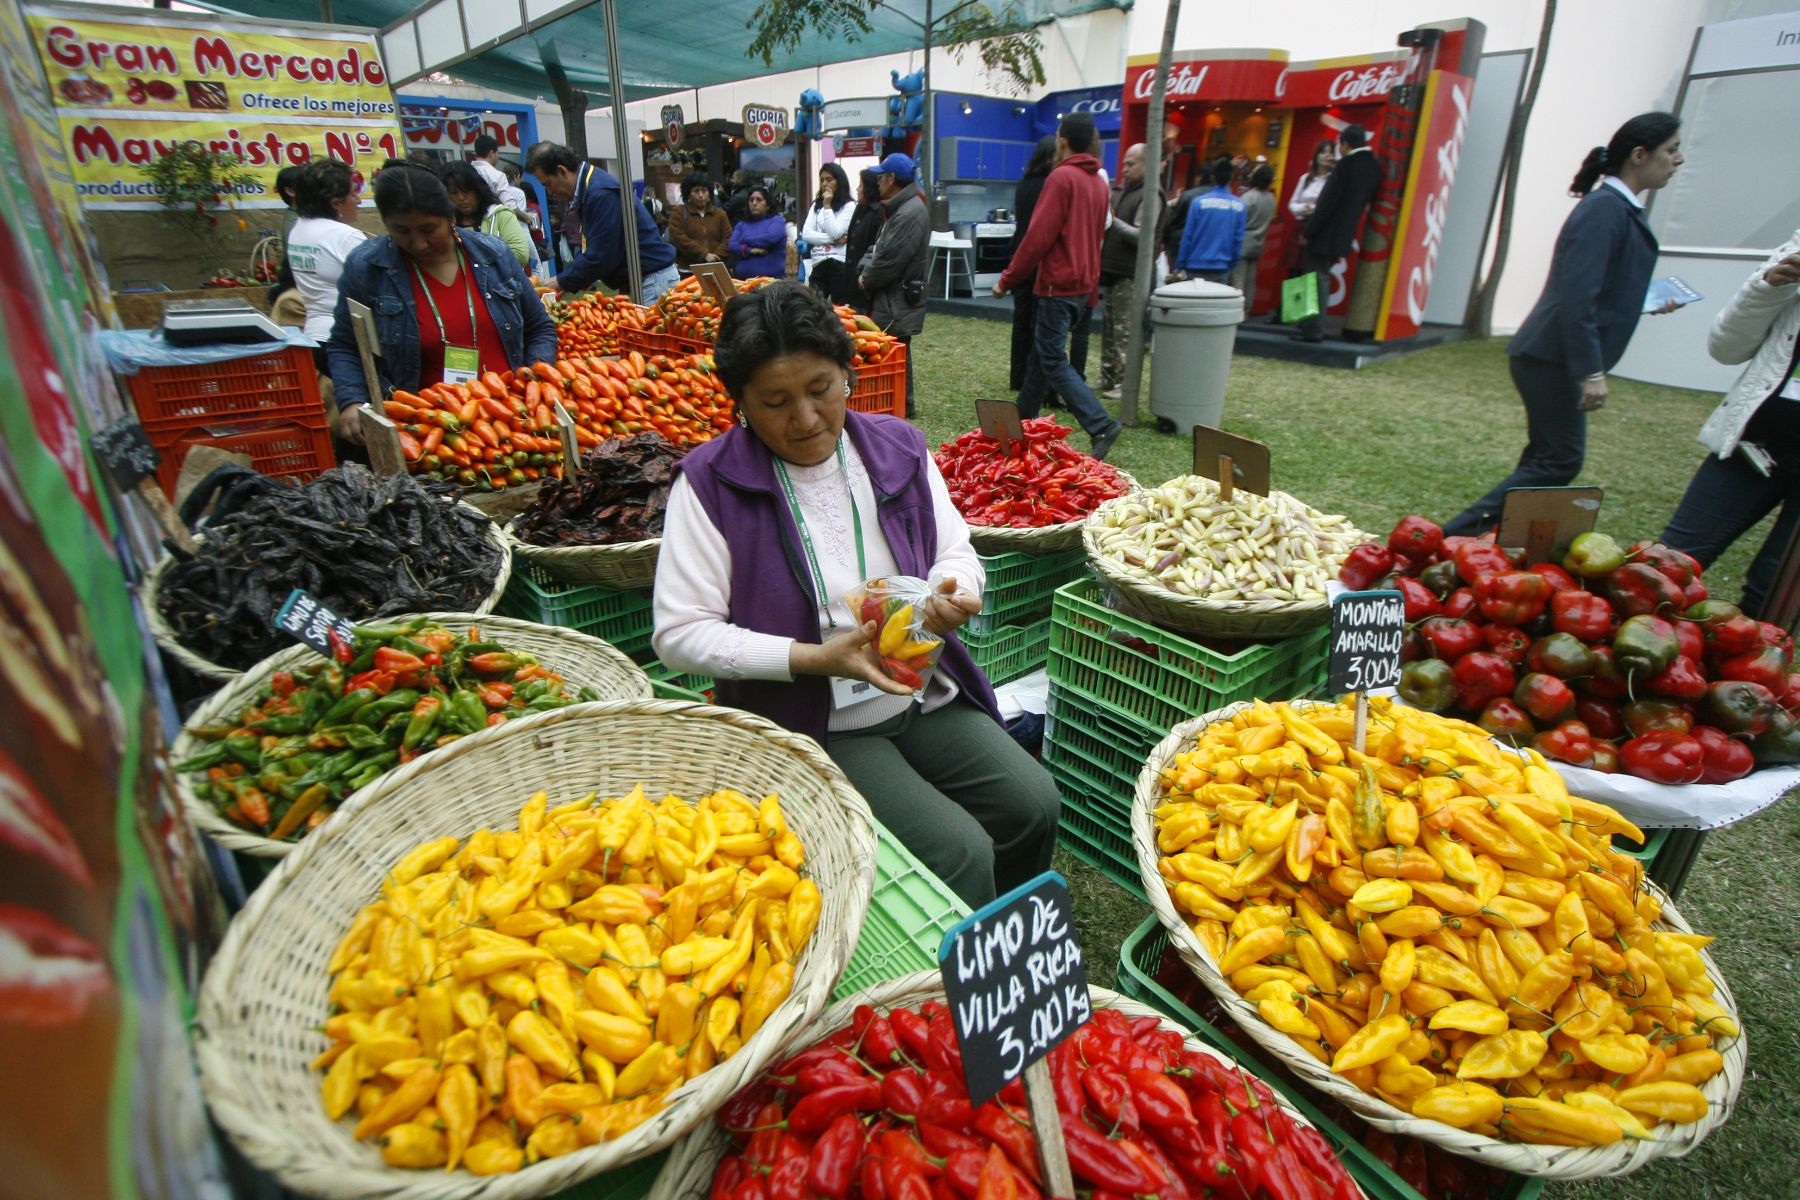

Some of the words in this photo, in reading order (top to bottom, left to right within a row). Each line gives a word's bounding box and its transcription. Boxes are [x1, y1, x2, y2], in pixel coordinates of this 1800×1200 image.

[47, 26, 177, 75] Gran
[194, 36, 386, 86] Mercado
[243, 93, 300, 110] Ofrece
[304, 96, 328, 111] los
[332, 99, 395, 115] mejores
[747, 108, 785, 128] GLORIA
[78, 180, 168, 195] producto
[1335, 629, 1403, 654] AMARILLO
[1028, 895, 1068, 946] DE
[958, 974, 1026, 1039] VILLA
[1026, 938, 1082, 996] RICA
